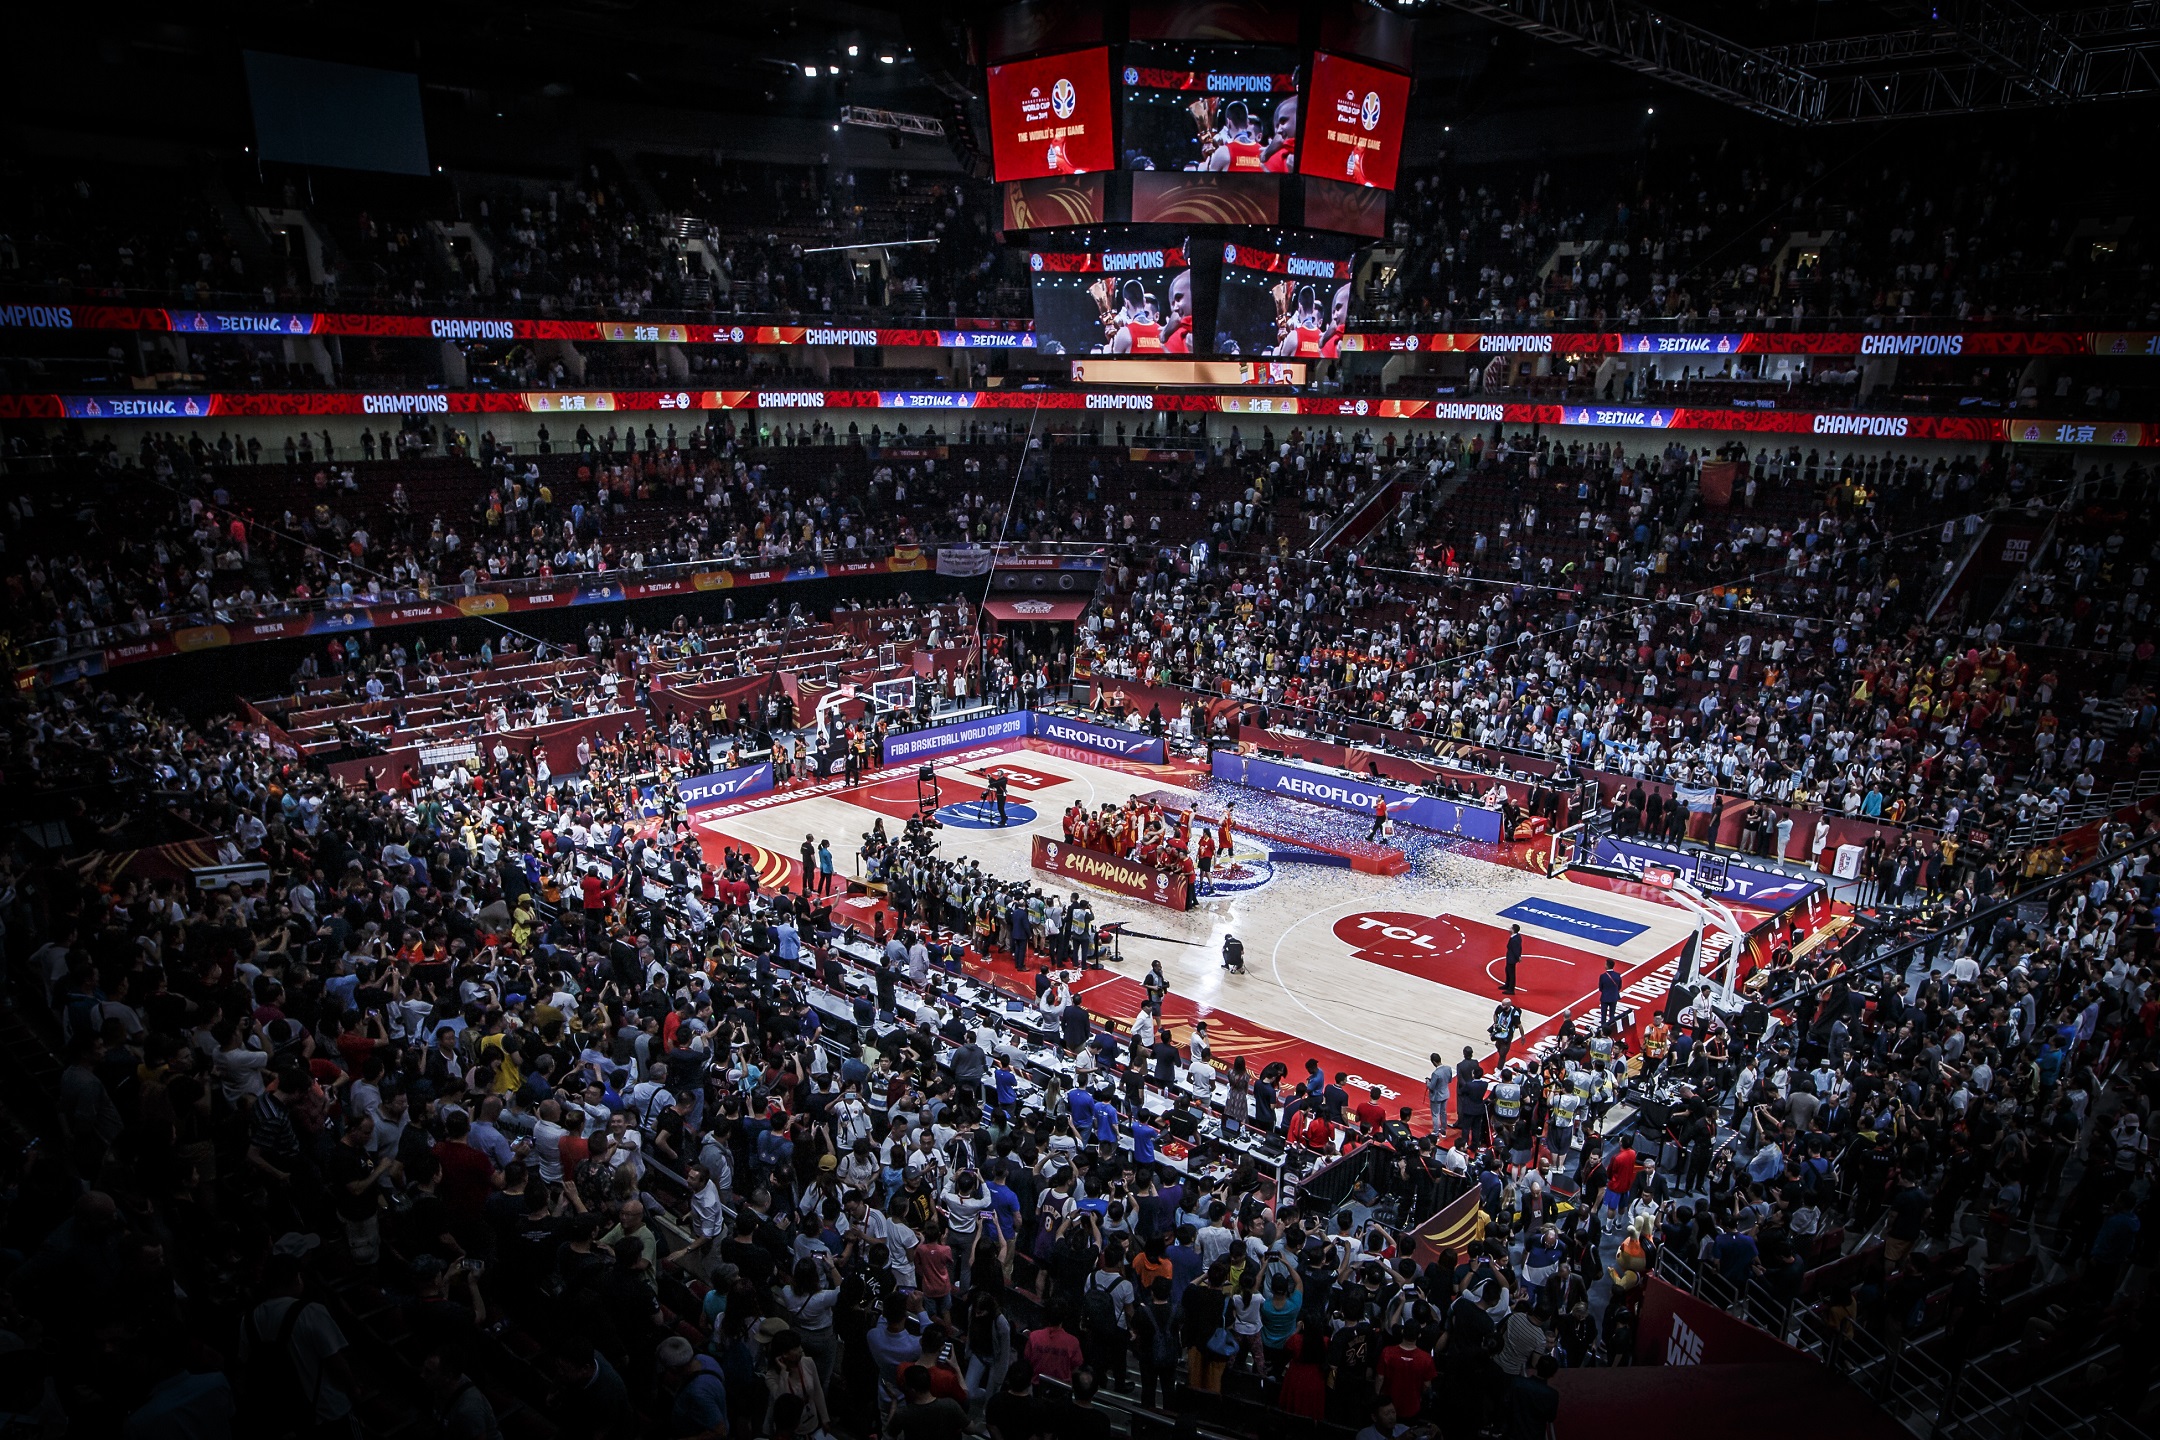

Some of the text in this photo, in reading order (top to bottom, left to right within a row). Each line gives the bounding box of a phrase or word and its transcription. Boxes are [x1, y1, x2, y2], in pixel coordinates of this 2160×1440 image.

[1207, 74, 1272, 92] CHAMPIONS
[1018, 131, 1028, 143] THE
[1029, 127, 1054, 141] WORLD'S
[1067, 124, 1084, 136] GAME
[1327, 129, 1336, 141] THE
[1337, 132, 1358, 145] WORLD'S
[1367, 139, 1381, 151] GAME
[1103, 250, 1164, 271] CHAMPIONS
[1287, 257, 1335, 278] CHAMPIONS
[430, 318, 514, 339] CHAMPIONS
[634, 325, 660, 341] 北京
[805, 328, 877, 346] CHAMPIONS
[1479, 334, 1553, 352] CHAMPIONS
[1861, 334, 1963, 356] CHAMPIONS
[362, 393, 449, 414] CHAMPIONS
[560, 394, 586, 410] 北京
[758, 392, 825, 408] CHAMPIONS
[1085, 393, 1154, 410] CHAMPIONS
[1248, 399, 1272, 413] 北京
[1435, 402, 1503, 421] CHAMPIONS
[1813, 414, 1908, 437] CHAMPIONS
[2056, 424, 2096, 444] 北京
[2005, 539, 2031, 550] EXIT
[891, 720, 1021, 757] FIBA BASKETBALL WORLD CUP 2019
[1046, 724, 1128, 752] AEROFLOT
[1276, 775, 1379, 809] AEROFLOT
[695, 802, 749, 820] FIBA
[1065, 853, 1149, 890] CHAMPIONS
[1516, 905, 1601, 930] AEROFLOT
[1356, 916, 1438, 950] TCL
[1045, 1215, 1053, 1232] 8
[1671, 1312, 1704, 1365] THE
